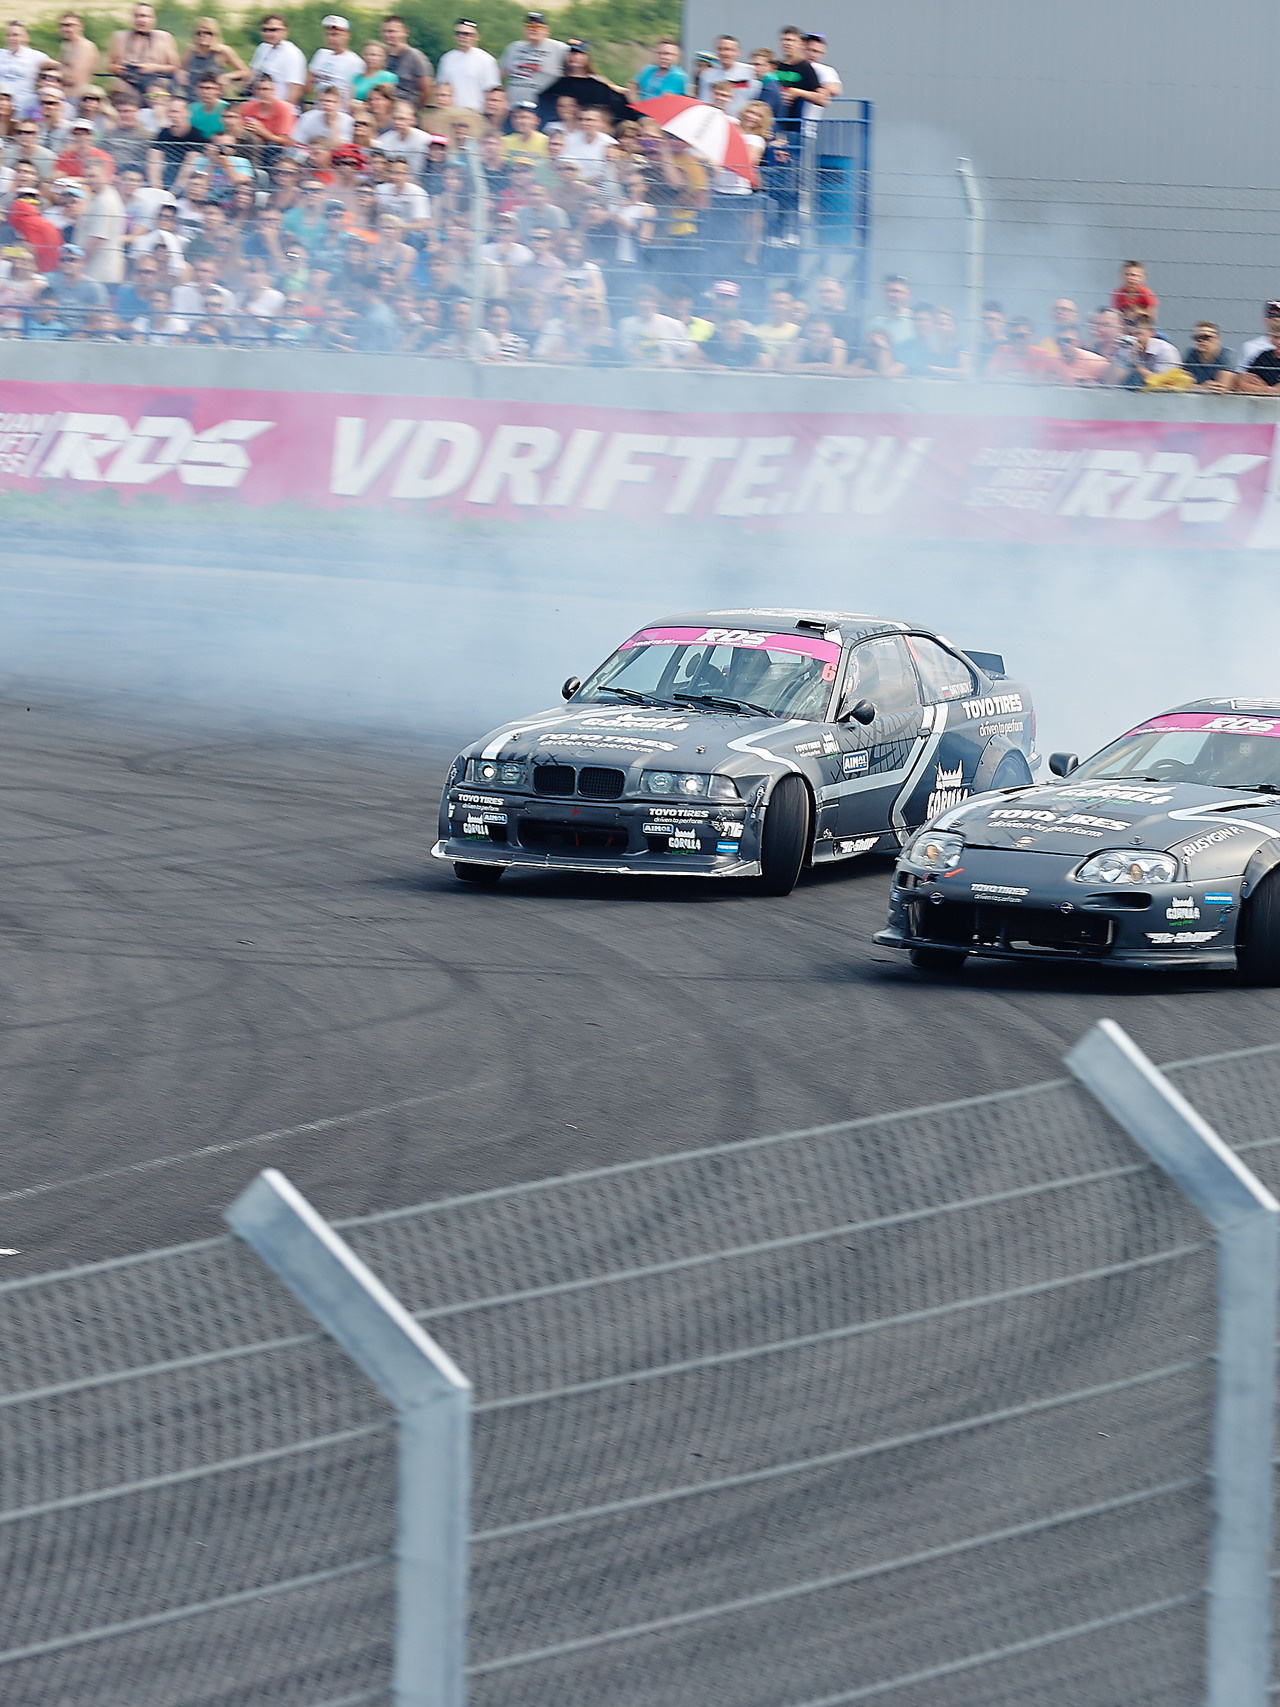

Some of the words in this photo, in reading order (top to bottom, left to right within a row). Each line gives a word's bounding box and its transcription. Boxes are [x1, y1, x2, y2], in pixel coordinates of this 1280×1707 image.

[40, 412, 278, 488] RDS
[330, 416, 934, 518] VDRIFTE.RU
[1060, 449, 1271, 523] RDS
[696, 628, 778, 647] RDS
[821, 662, 838, 682] 6
[961, 696, 996, 719] TOYO
[995, 693, 1023, 715] TIRES
[979, 720, 1000, 737] driven
[1004, 718, 1024, 736] perform
[537, 733, 604, 742] TOYO
[602, 735, 679, 751] TIRES
[458, 793, 480, 803] TOYO
[480, 796, 505, 806] TIRES
[1056, 788, 1174, 805] GORILLA
[649, 808, 678, 817] TOYO
[677, 809, 710, 818] TIRES
[987, 809, 1058, 822] TOYO
[1053, 813, 1133, 831] TIRES
[987, 819, 1031, 829] driven
[1044, 825, 1104, 838] perform
[1181, 828, 1235, 857] BUSYGIN
